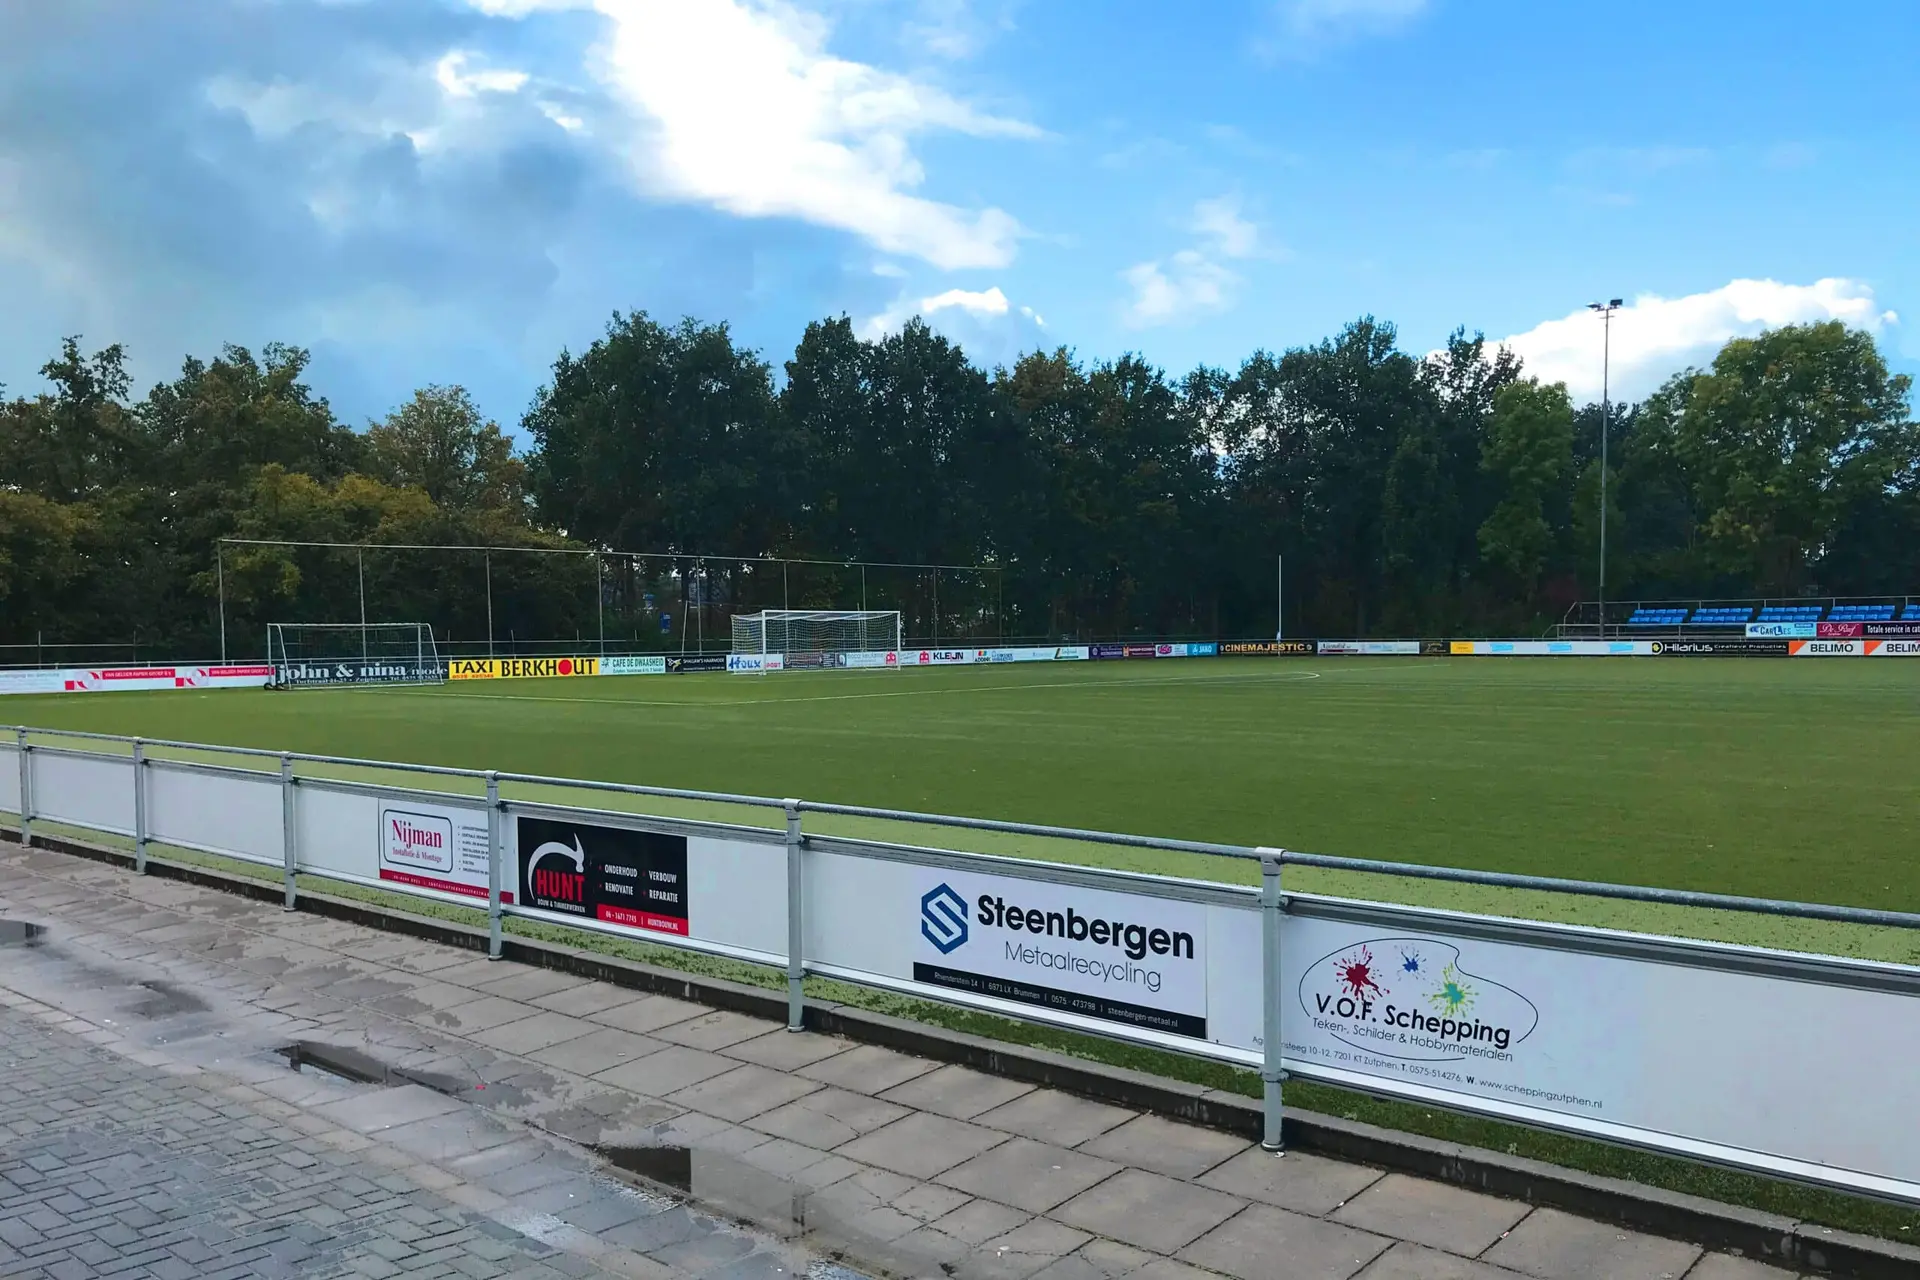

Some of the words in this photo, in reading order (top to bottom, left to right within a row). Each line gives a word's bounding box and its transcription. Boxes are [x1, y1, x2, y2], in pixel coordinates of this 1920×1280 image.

[1867, 625, 1883, 633] Totale
[1885, 625, 1903, 633] service
[1905, 625, 1910, 633] in
[1225, 643, 1305, 652] CINEMAJESTIC
[1664, 643, 1713, 652] Hilarius
[1811, 643, 1853, 653] BELIMO
[933, 652, 964, 660] KLEIJN
[451, 661, 493, 673] TAXI
[501, 659, 596, 677] BERKHOUT
[612, 659, 625, 667] CAFE
[627, 659, 634, 667] DE
[277, 664, 330, 683] john
[336, 664, 354, 677] &
[360, 662, 406, 676] nina
[392, 819, 442, 848] Nijman
[604, 864, 637, 877] ONDERHOUD
[648, 870, 677, 883] VERBOUW
[536, 868, 585, 902] HUNT
[604, 882, 634, 895] RENOVATIE
[649, 889, 678, 903] REPARATIE
[605, 910, 611, 919] 06
[977, 894, 1194, 960] Steenbergen
[1005, 940, 1162, 992] Metaalrecycling
[1013, 987, 1041, 999] Brummen
[1051, 994, 1067, 1005] 0575
[1315, 993, 1377, 1023] V.O.F.
[1384, 1004, 1510, 1050] Schepping
[1353, 1024, 1396, 1042] Schilder
[1399, 1033, 1407, 1044] &
[1410, 1036, 1513, 1062] Hobbymaterialen
[1334, 1050, 1351, 1061] 7201
[1354, 1055, 1363, 1063] KT
[1480, 1080, 1603, 1109] www.scheppingzutphen.nl
